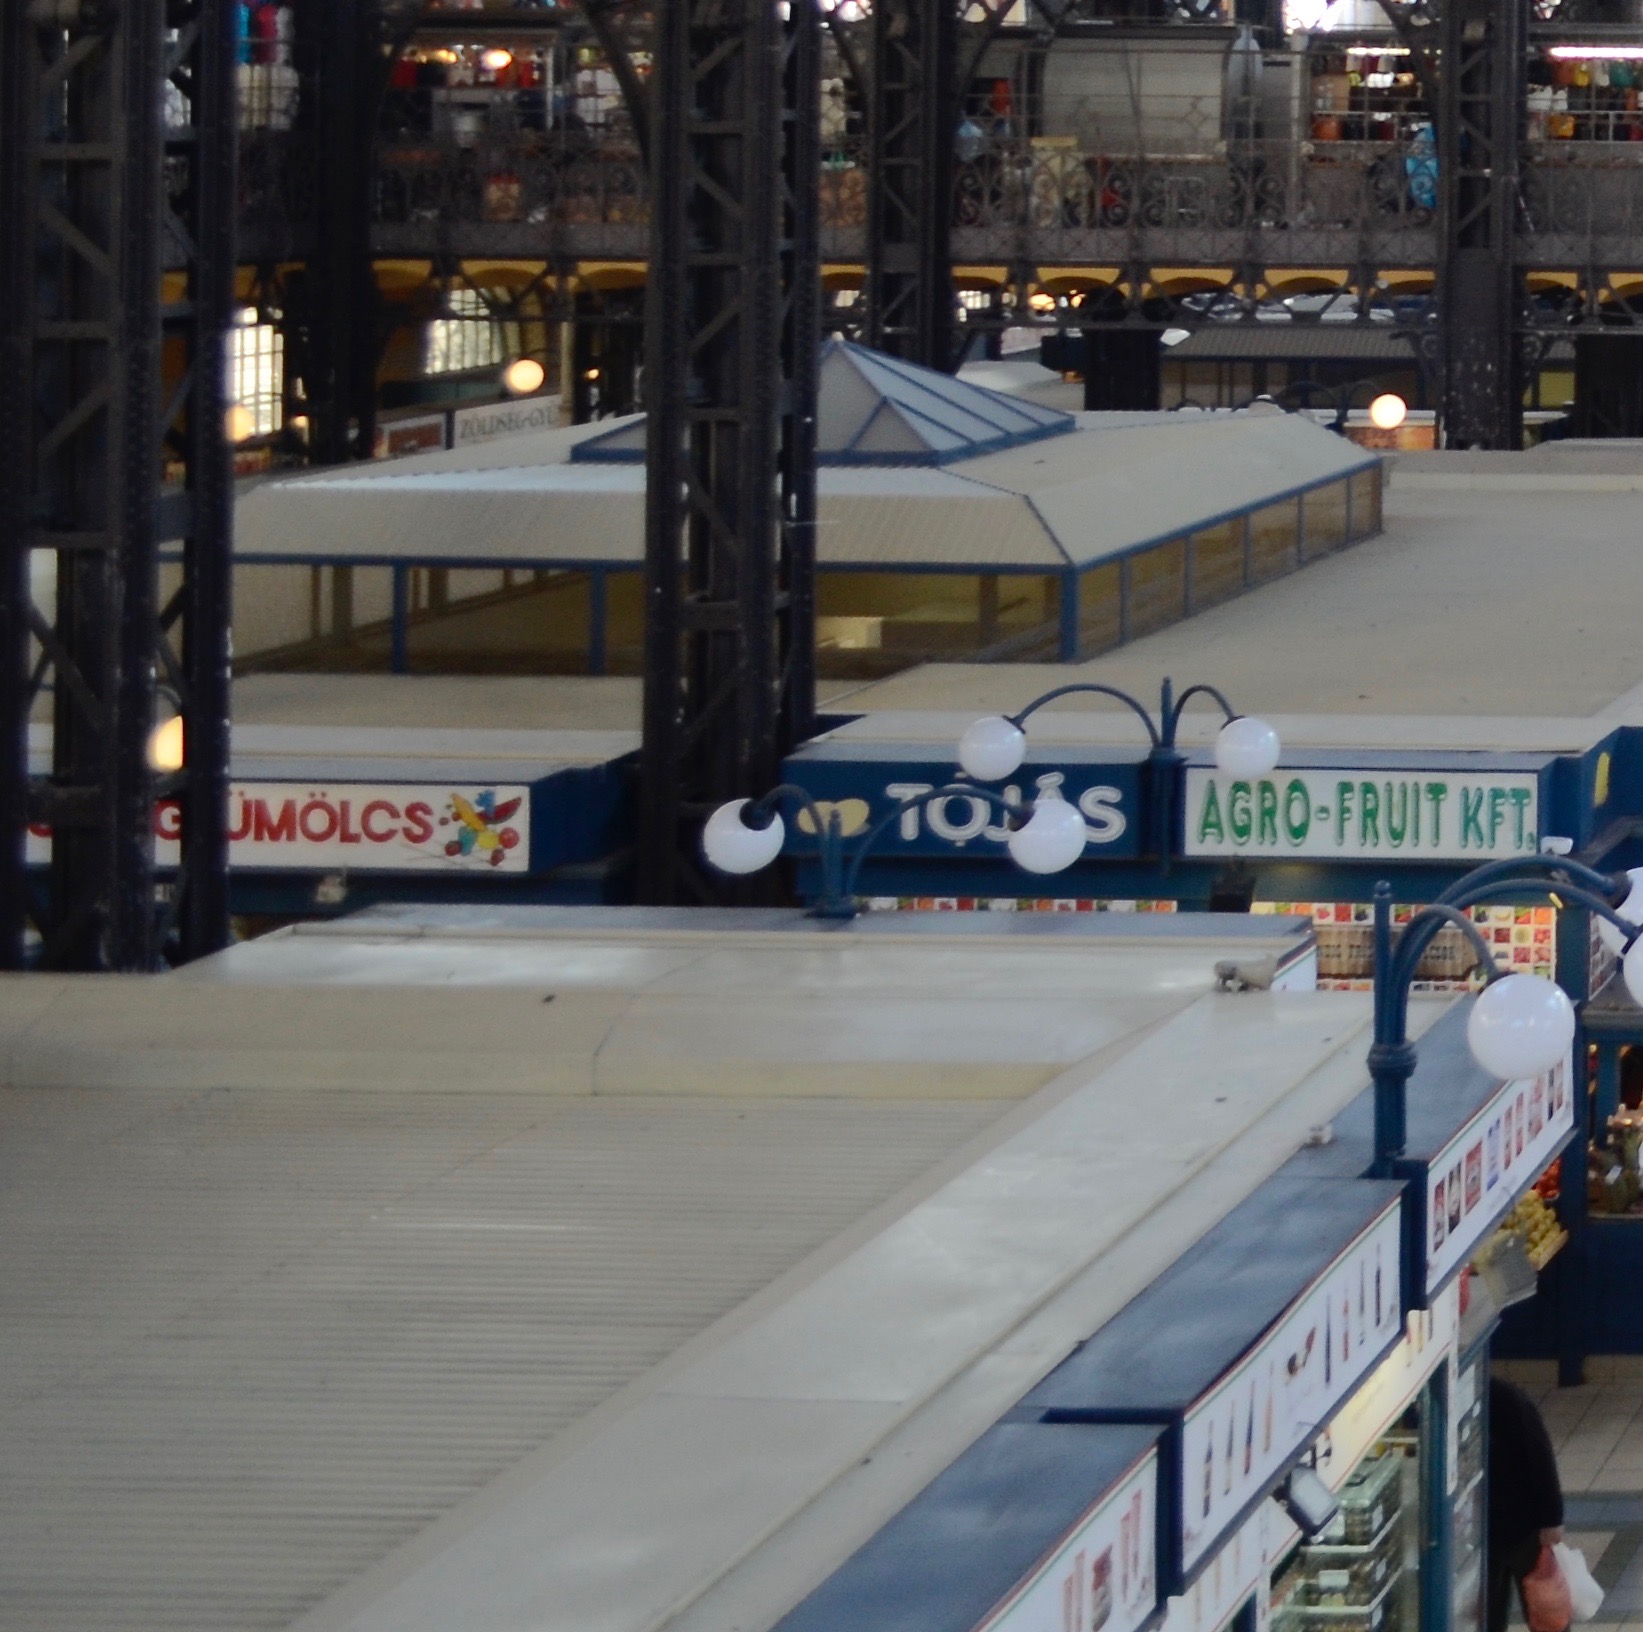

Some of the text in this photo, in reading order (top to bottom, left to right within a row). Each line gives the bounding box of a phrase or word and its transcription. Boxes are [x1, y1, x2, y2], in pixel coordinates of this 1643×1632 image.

[152, 790, 435, 845] GÜMÖLCS
[884, 771, 1128, 847] TOJS
[1196, 777, 1537, 852] AGRO-FRUIT KFT.
